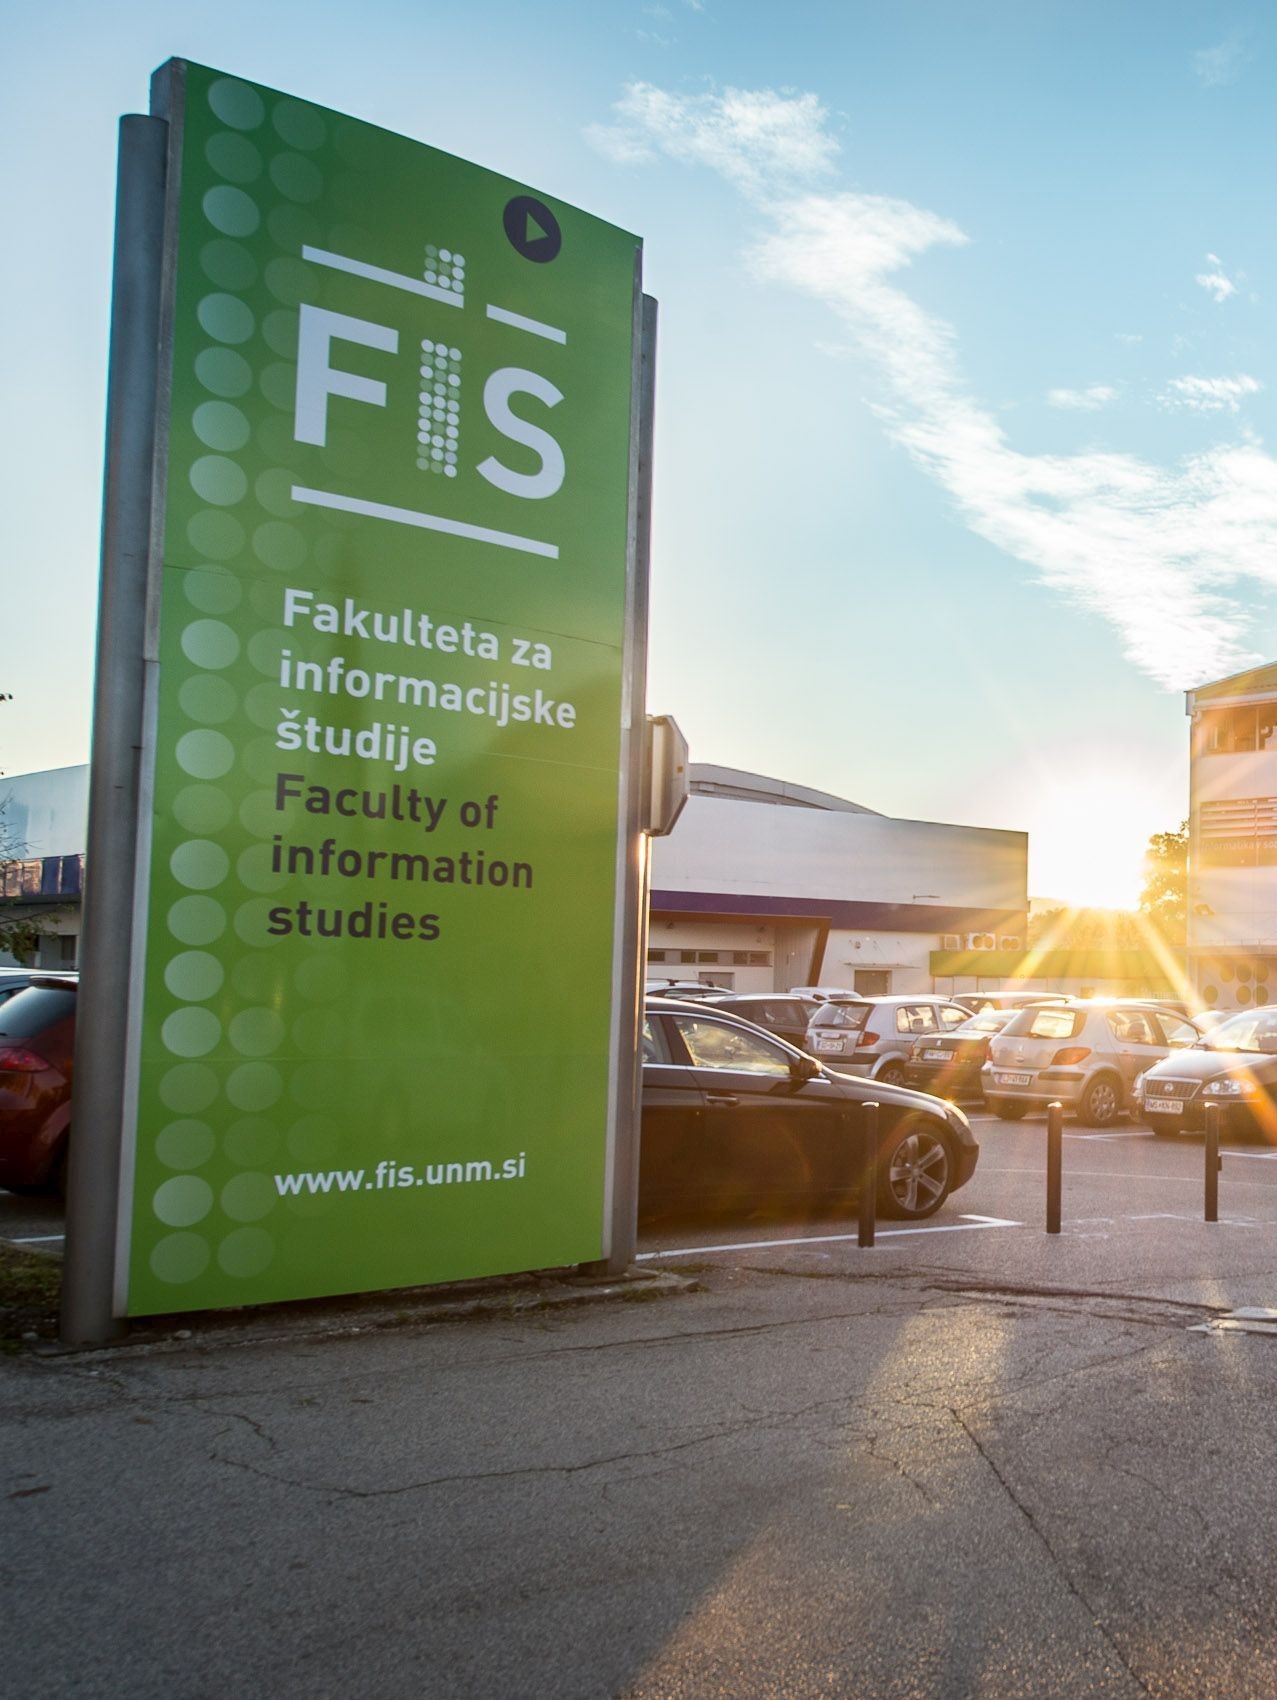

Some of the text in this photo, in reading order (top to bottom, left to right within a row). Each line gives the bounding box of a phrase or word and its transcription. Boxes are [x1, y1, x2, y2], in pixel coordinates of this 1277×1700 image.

[283, 587, 552, 671] Fakulteta za
[280, 648, 577, 729] informacijske
[275, 707, 437, 771] študije
[275, 772, 499, 832] Faculty of
[271, 834, 533, 889] information
[266, 901, 441, 941] studies
[274, 1152, 526, 1196] www.fis.unm.si
